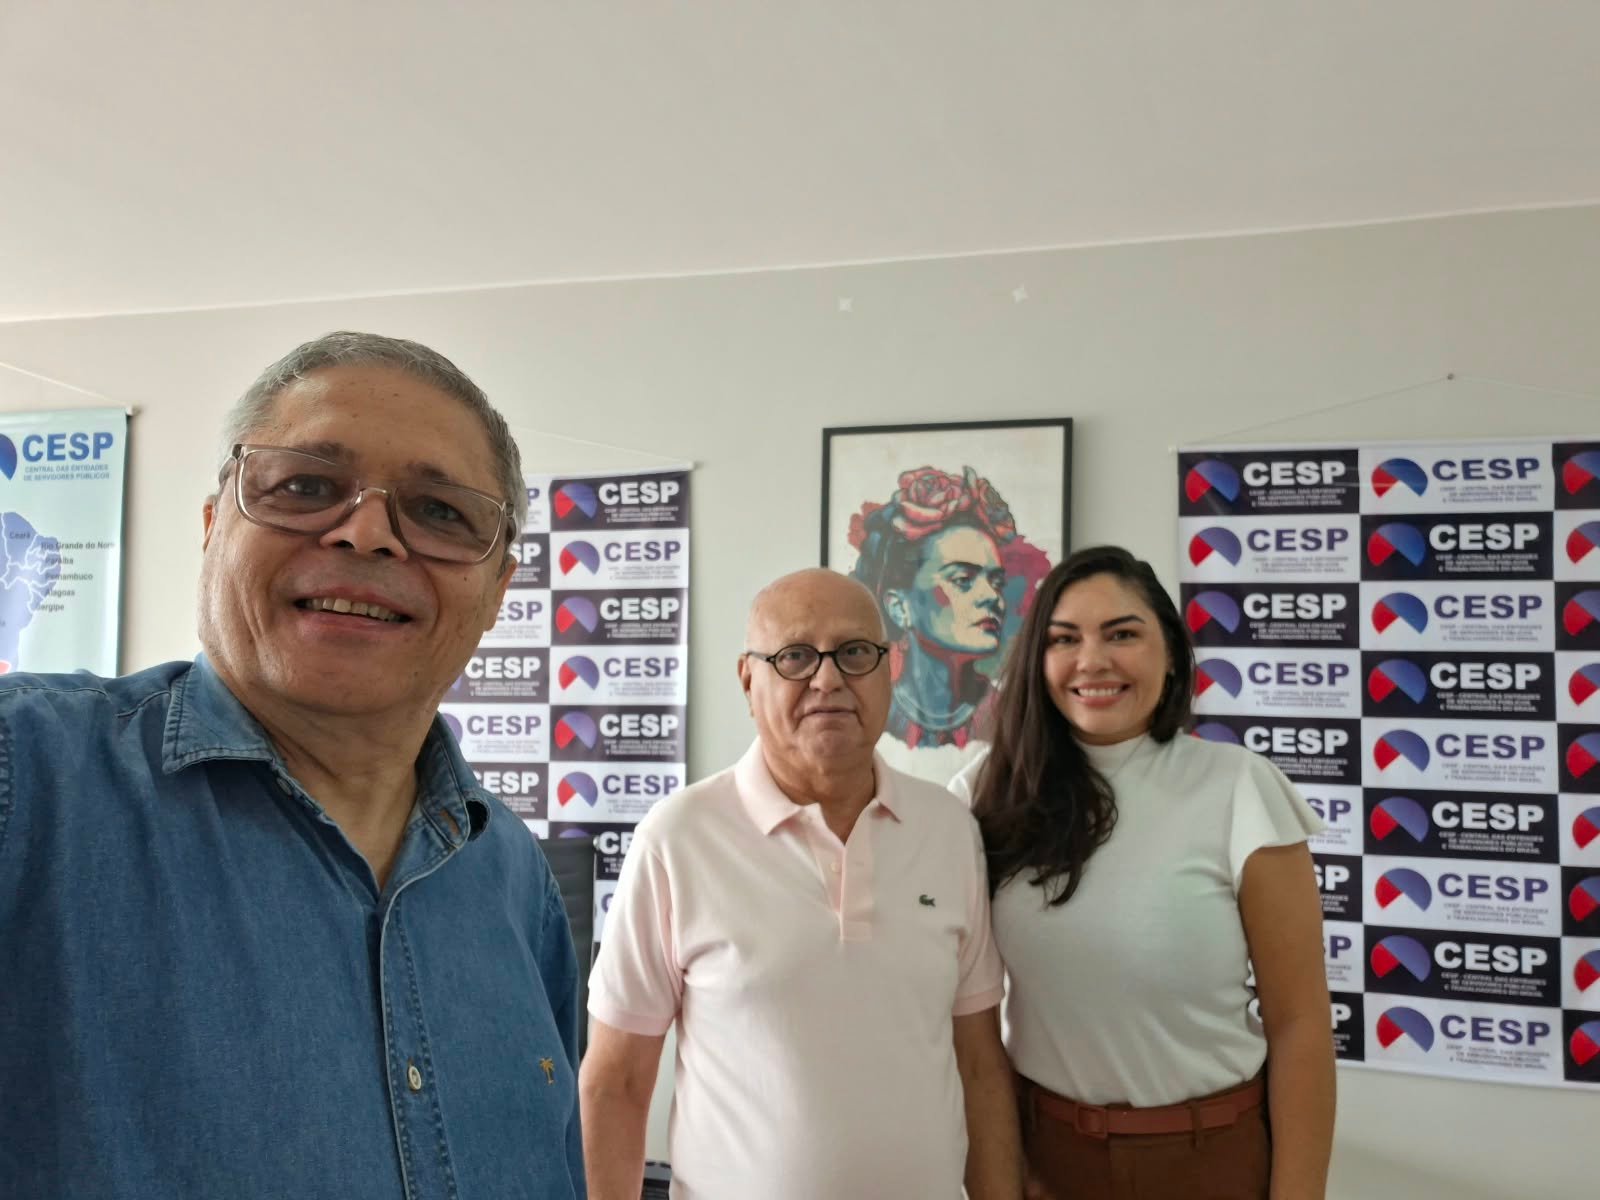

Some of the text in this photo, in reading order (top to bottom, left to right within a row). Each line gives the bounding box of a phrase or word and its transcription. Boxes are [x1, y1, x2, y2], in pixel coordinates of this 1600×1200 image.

[22, 432, 113, 462] CESP
[25, 465, 54, 473] CENTRAL
[71, 463, 108, 471] ENTIDADES
[1243, 461, 1346, 486] CESP
[1432, 457, 1540, 481] CESP
[598, 481, 680, 505] CESP
[41, 541, 53, 549] Rio
[56, 541, 83, 550] Grande
[85, 540, 95, 549] do
[1247, 528, 1349, 552] CESP
[1429, 522, 1540, 551] CESP
[604, 541, 681, 562] CESP
[600, 597, 680, 621] CESP
[1243, 593, 1347, 620] CESP
[1433, 594, 1542, 620] CESP
[464, 656, 541, 679] CESP
[603, 657, 680, 678] CESP
[1247, 662, 1350, 686] CESP
[1429, 661, 1541, 690] CESP
[466, 715, 541, 736] CESP
[599, 713, 679, 738] CESP
[1243, 725, 1349, 754] CESP
[1435, 733, 1545, 760] CESP
[602, 774, 679, 795] CESP
[1431, 801, 1544, 831] CESP
[1437, 873, 1549, 902] CESP
[1433, 941, 1548, 974] CESP
[1439, 1015, 1551, 1046] CESP
